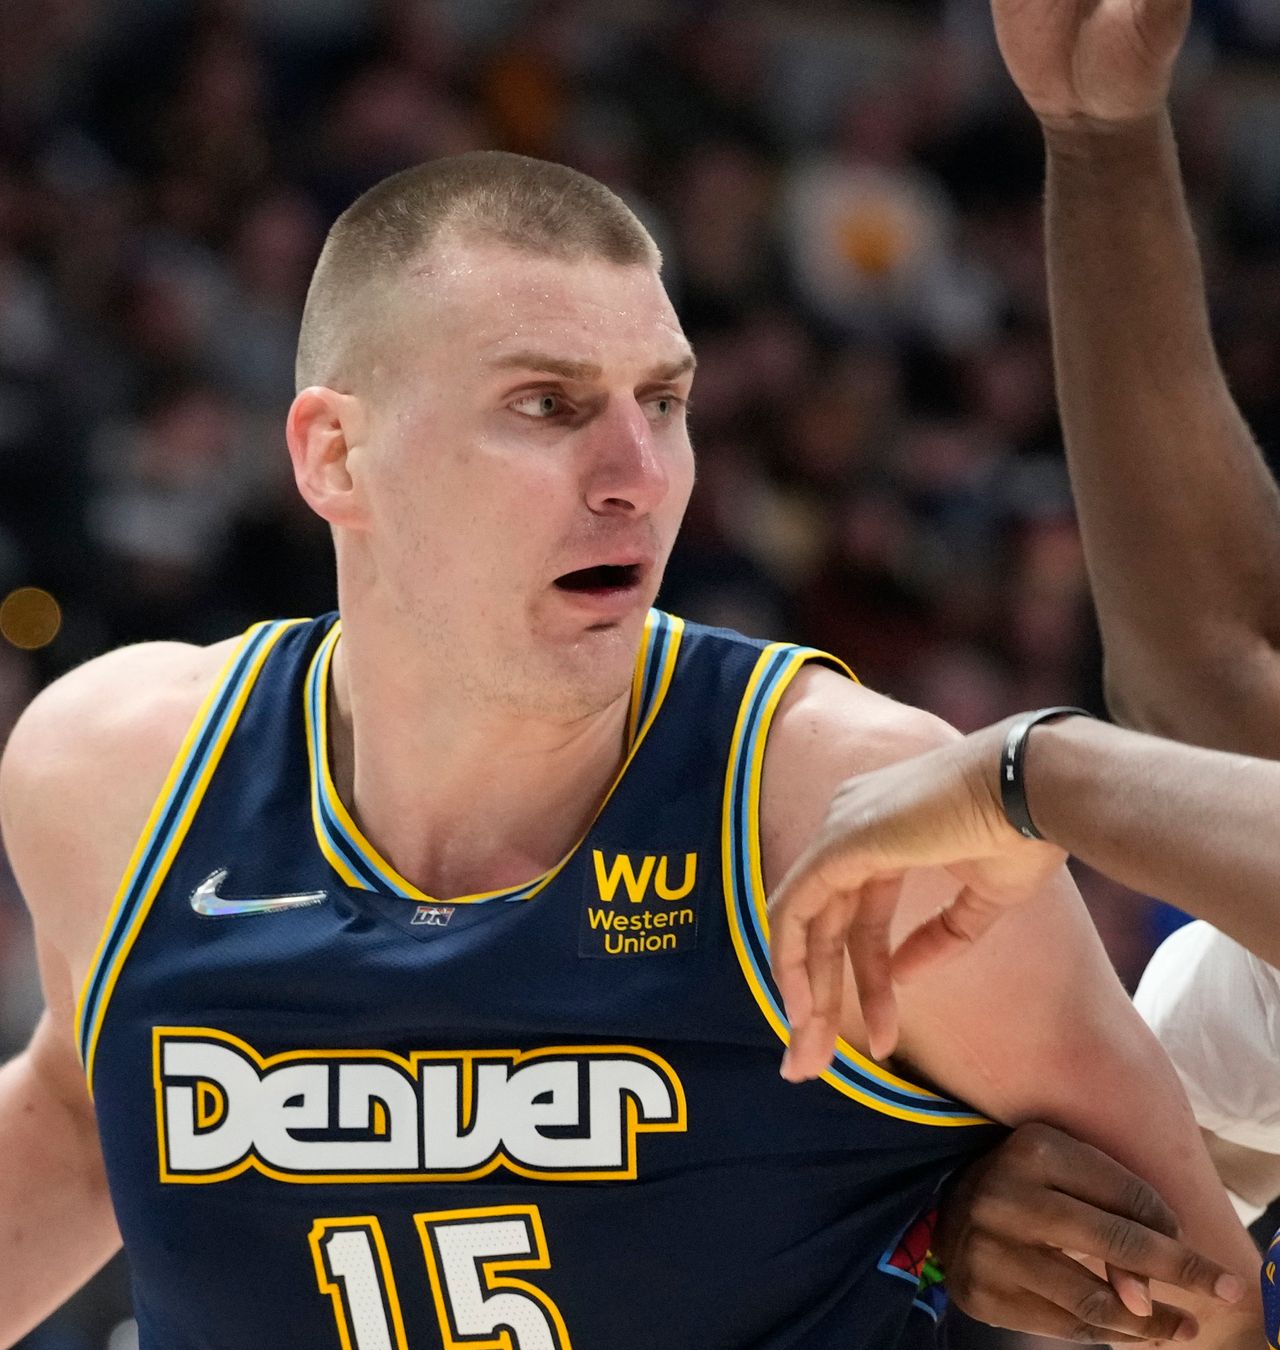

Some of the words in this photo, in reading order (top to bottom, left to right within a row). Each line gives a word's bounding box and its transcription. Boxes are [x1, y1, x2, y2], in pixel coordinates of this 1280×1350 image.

[593, 849, 697, 903] WU
[588, 906, 693, 932] Western
[605, 932, 677, 954] Union
[152, 1027, 687, 1184] Denver
